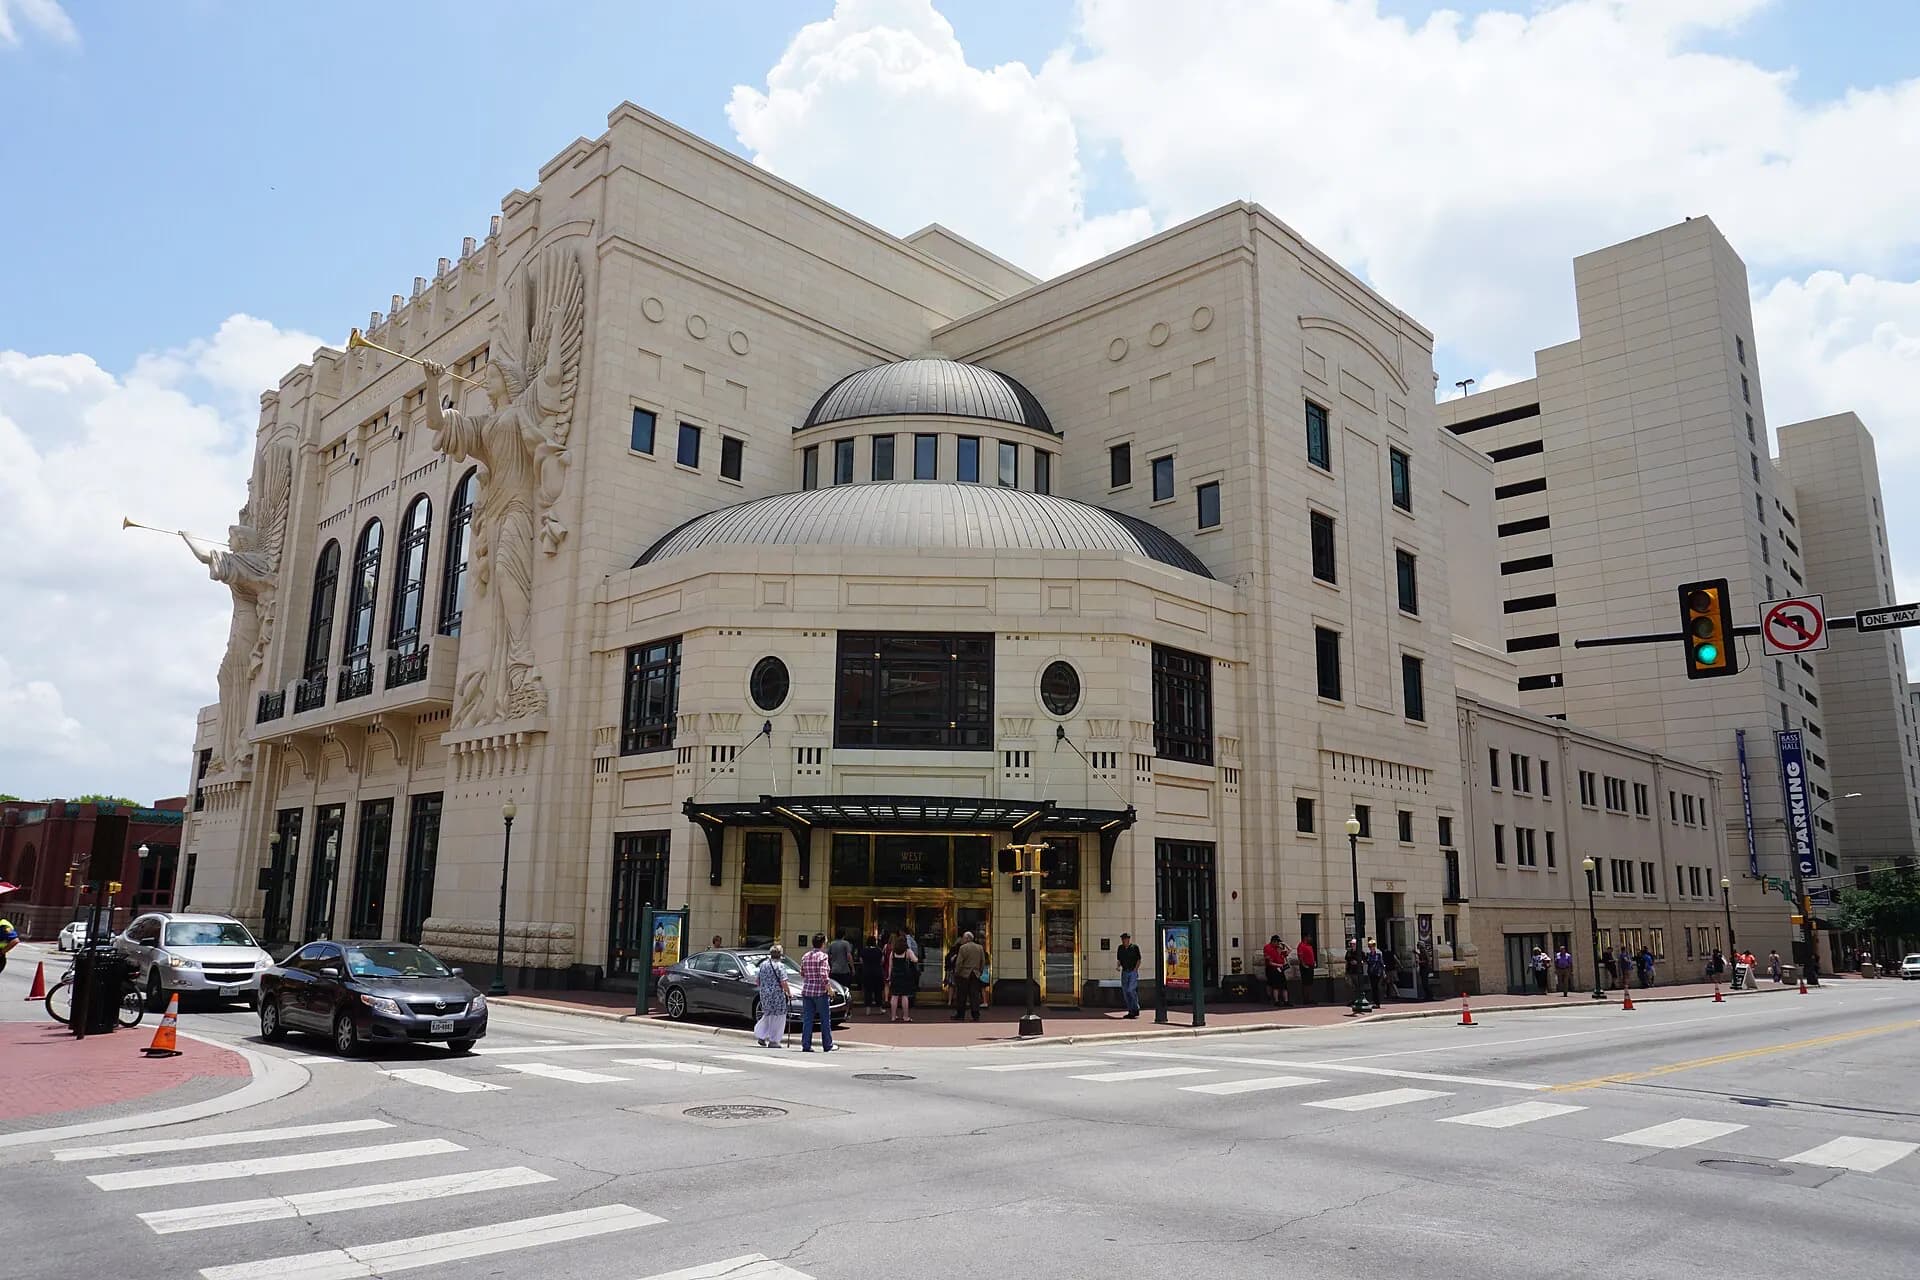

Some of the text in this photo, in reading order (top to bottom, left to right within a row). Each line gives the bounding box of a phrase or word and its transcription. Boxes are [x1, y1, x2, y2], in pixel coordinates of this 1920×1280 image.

[1865, 610, 1916, 625] ONE WAY
[1786, 761, 1811, 855] PARKING
[901, 851, 922, 861] WEST
